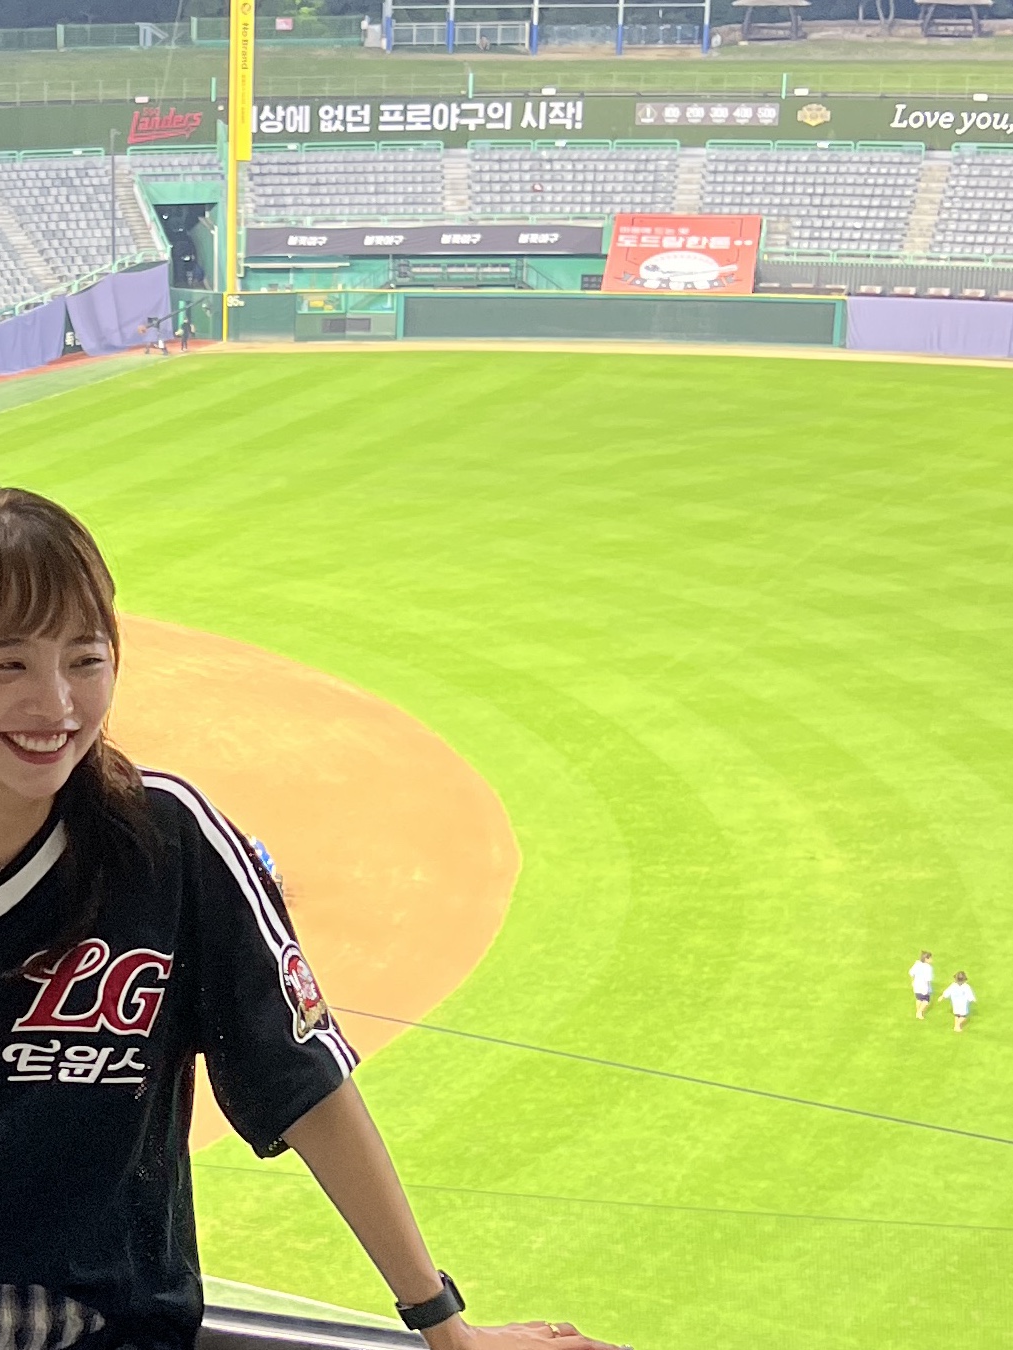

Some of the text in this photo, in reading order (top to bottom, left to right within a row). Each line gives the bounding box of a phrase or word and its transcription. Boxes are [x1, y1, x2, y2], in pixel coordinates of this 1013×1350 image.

[127, 107, 202, 144] Landers
[252, 101, 583, 133] 상에 없던 프로야구의 시작!
[890, 104, 1013, 135] Love you,
[11, 938, 174, 1037] LG
[2, 1039, 145, 1084] 트윈스
